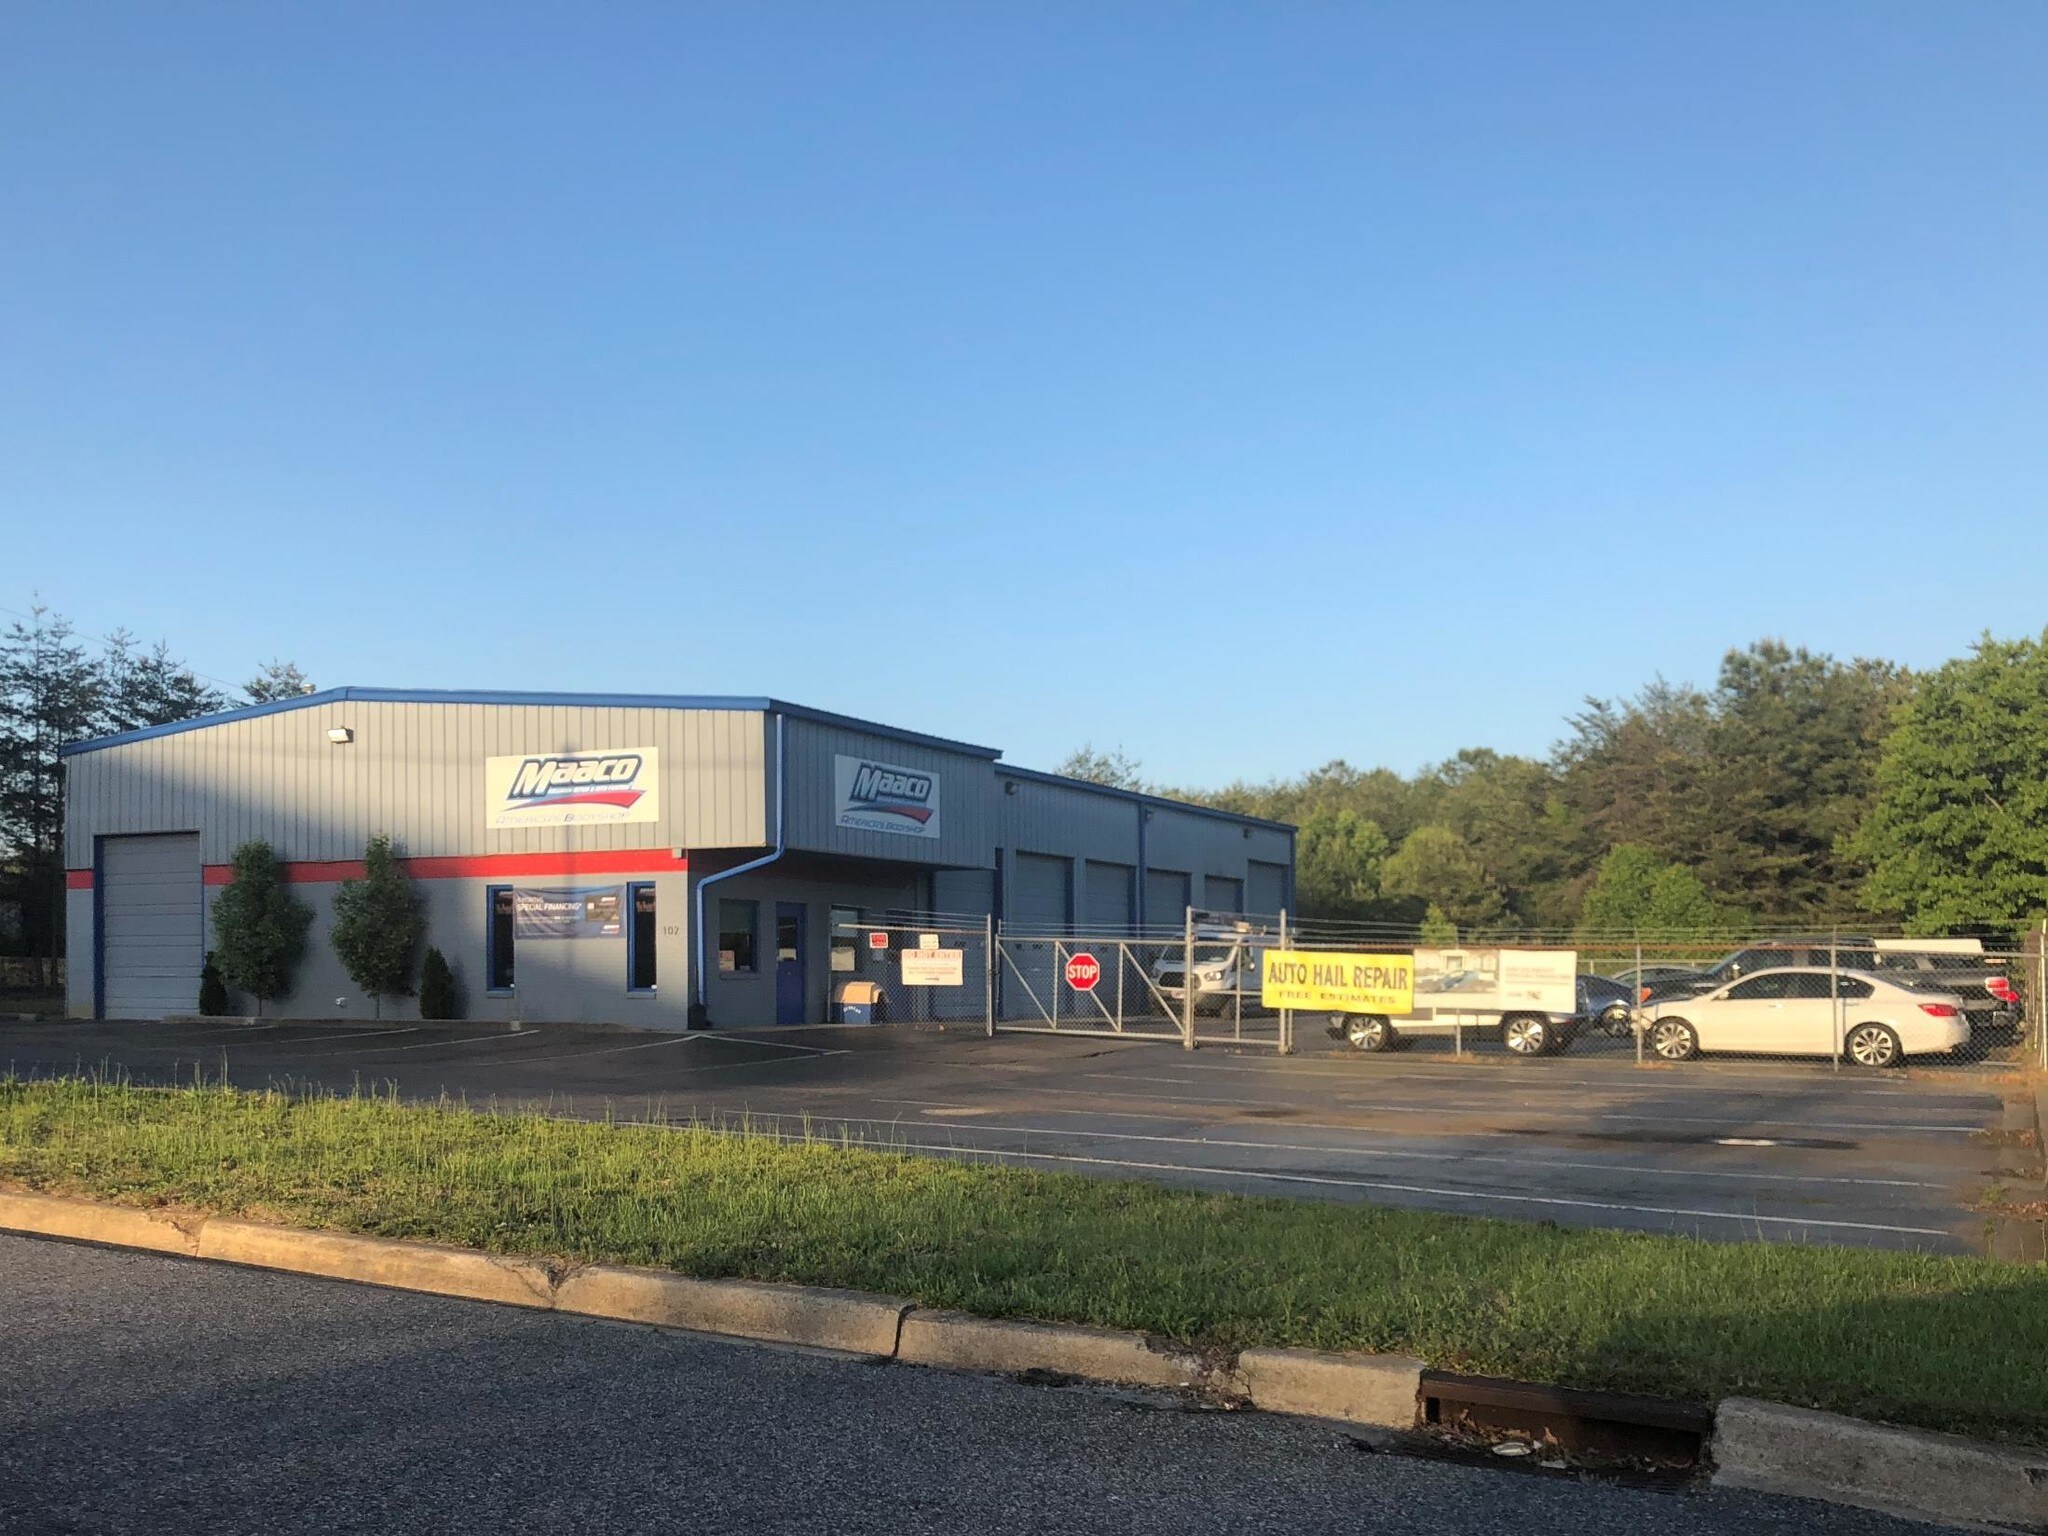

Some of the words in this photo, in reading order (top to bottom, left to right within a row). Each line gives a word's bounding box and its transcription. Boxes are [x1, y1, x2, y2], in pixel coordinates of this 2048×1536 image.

[508, 755, 641, 799] Maaco
[849, 762, 932, 803] Maaco
[663, 926, 679, 935] 102
[1068, 965, 1097, 979] STOP
[1268, 962, 1308, 985] AUTO
[1313, 964, 1348, 987] HAIL
[1353, 966, 1408, 990] REPAIR
[1279, 990, 1312, 1000] FREE
[1320, 992, 1396, 1004] ESTIMATES
